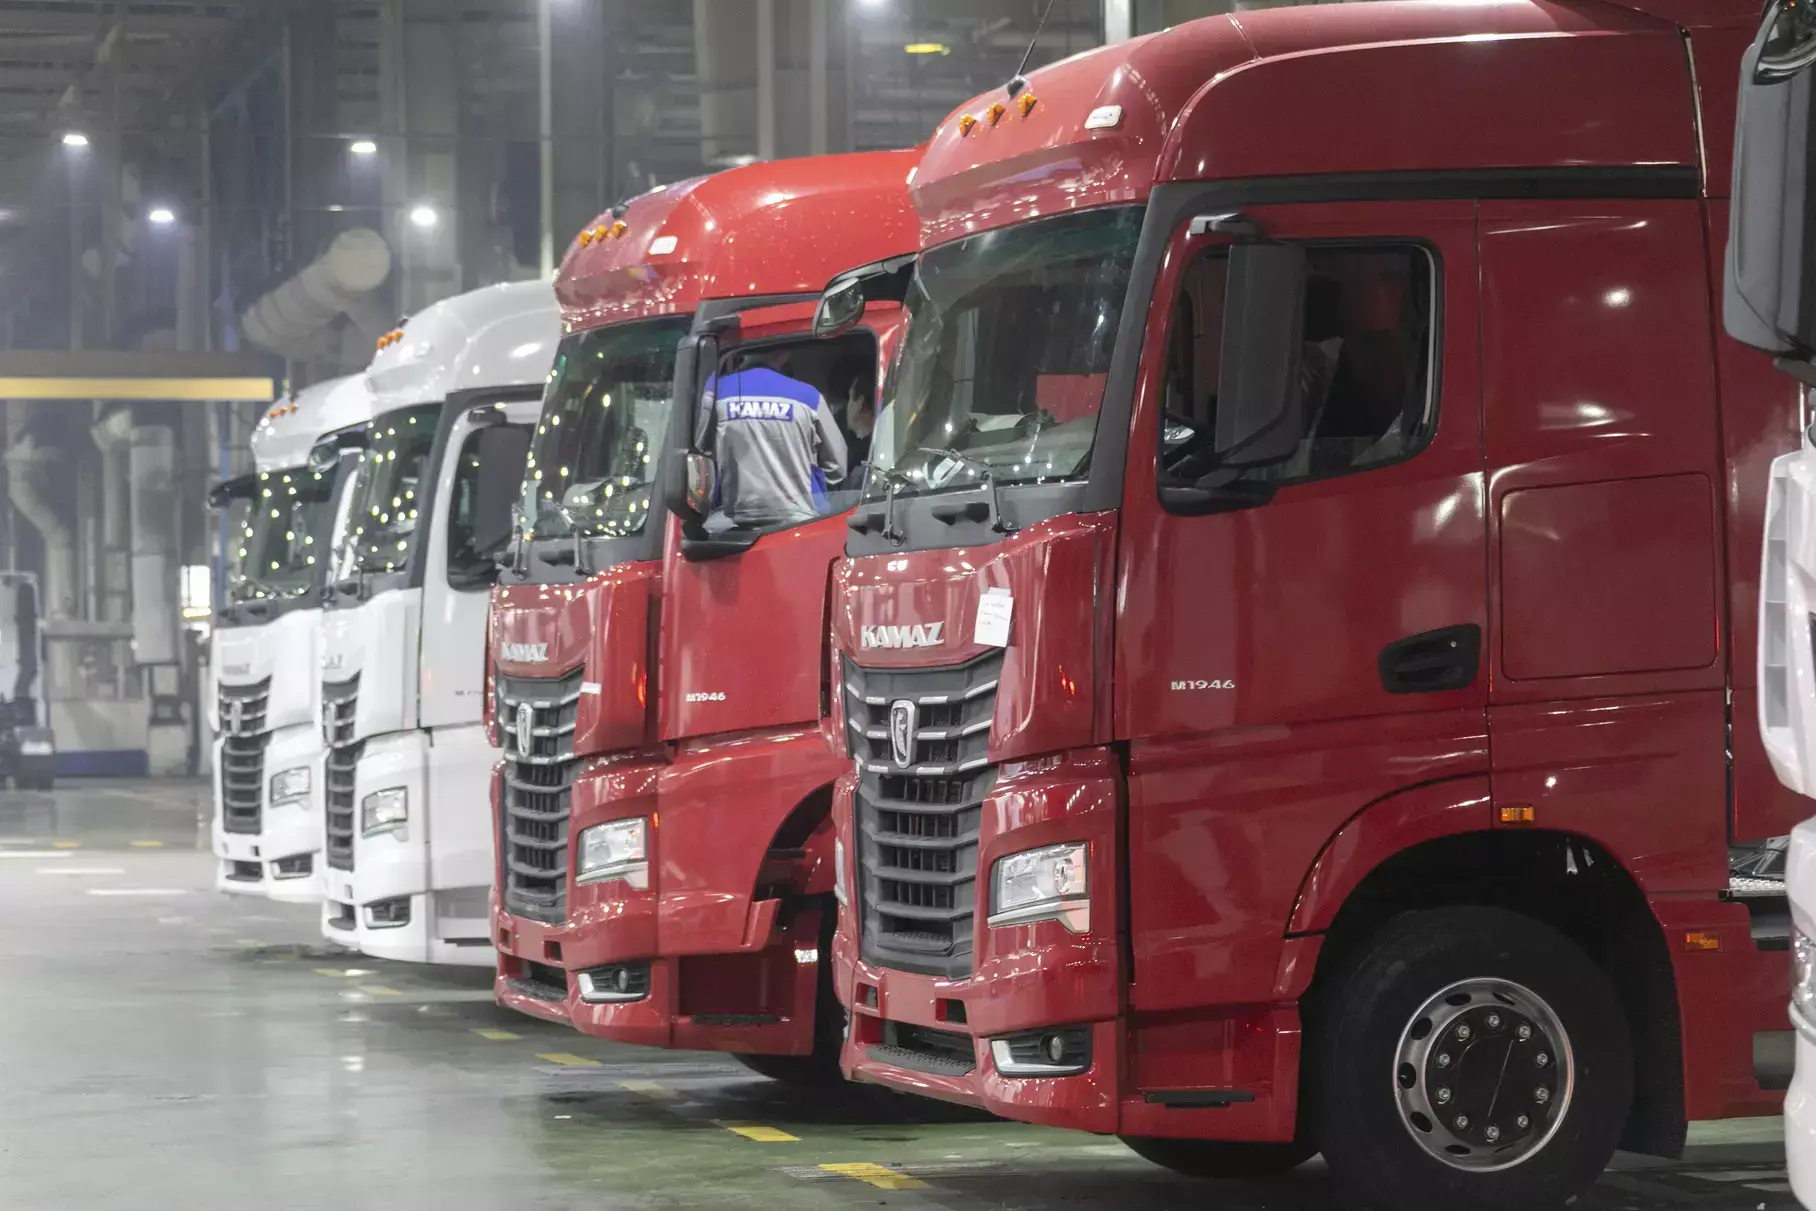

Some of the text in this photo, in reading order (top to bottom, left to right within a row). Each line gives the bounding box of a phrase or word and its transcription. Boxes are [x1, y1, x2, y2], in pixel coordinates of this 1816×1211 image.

[729, 402, 791, 419] KAMAZ
[860, 621, 945, 649] KAMAZ
[1171, 680, 1236, 691] M1946
